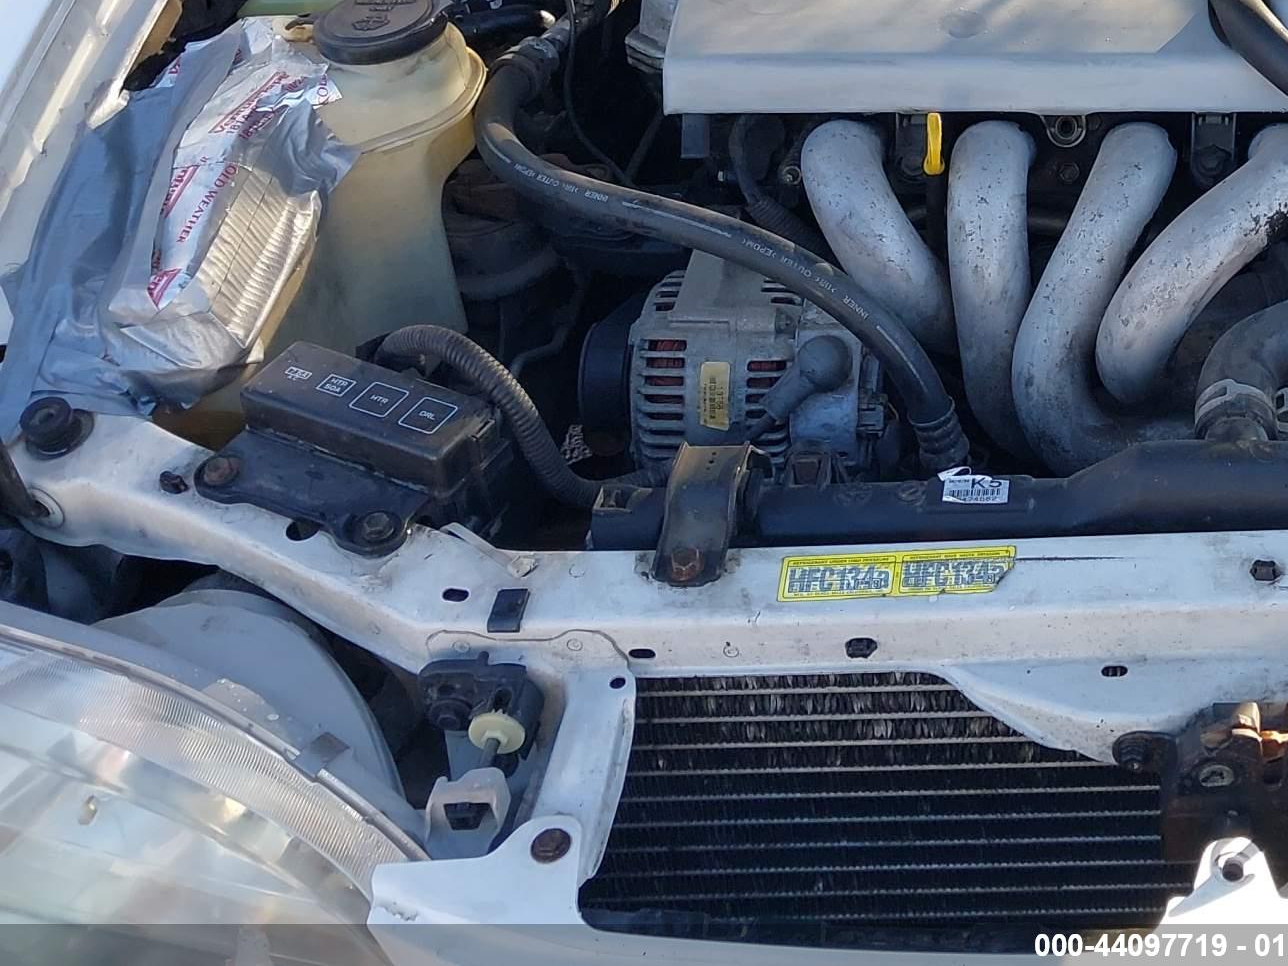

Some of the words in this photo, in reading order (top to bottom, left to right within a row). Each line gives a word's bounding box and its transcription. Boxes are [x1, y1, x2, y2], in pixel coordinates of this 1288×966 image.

[176, 185, 219, 243] WEATHER
[779, 255, 812, 277] OUTER
[843, 294, 869, 320] INNER
[323, 384, 341, 393] 50A
[330, 377, 349, 387] HTR
[370, 394, 389, 405] HTR
[418, 409, 436, 421] DRL
[971, 476, 1003, 489] K5
[788, 566, 890, 592] HFC134a
